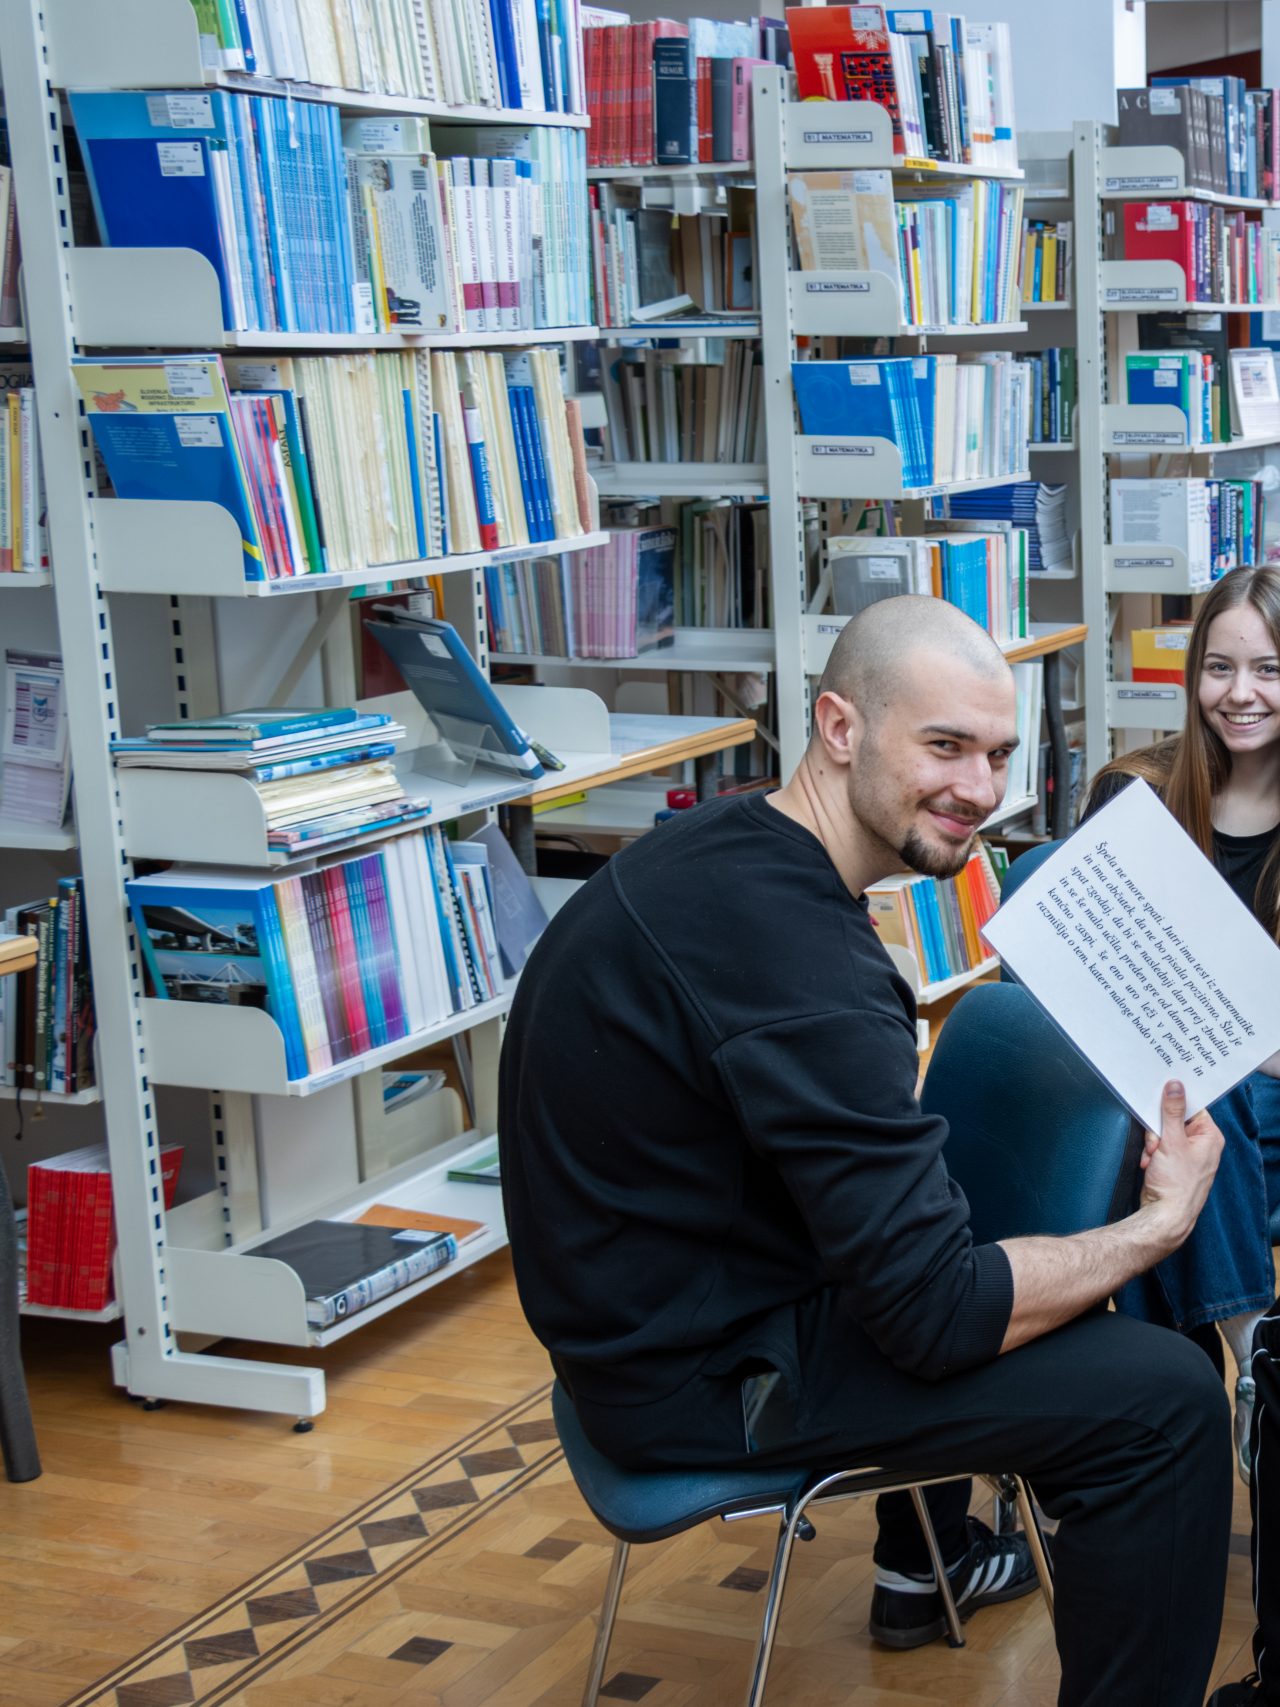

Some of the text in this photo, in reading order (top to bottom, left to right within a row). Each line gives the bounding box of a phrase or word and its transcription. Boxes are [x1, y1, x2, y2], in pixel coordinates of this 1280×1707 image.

[503, 189, 515, 281] TEMELJI LOGISTIČKE ŠPEDICIJE
[60, 900, 70, 931] Fisch
[1036, 901, 1069, 939] razmišlja
[1072, 945, 1087, 965] tem,
[1088, 962, 1111, 989] katere
[1109, 990, 1133, 1017] naloge
[1131, 1016, 1150, 1038] bodo
[1154, 1044, 1172, 1067] testu.
[1047, 887, 1073, 918] končno
[1074, 923, 1097, 948] zaspi,
[1097, 949, 1108, 960] še
[1109, 965, 1124, 980] eno
[1125, 984, 1139, 999] uro
[1140, 1001, 1158, 1018] leži
[1162, 1032, 1194, 1062] postelji
[1192, 1065, 1203, 1076] in
[1058, 875, 1216, 1066] in se še malo učila, preden gre od doma. Preden
[1070, 866, 1229, 1056] spat zgodaj, da bi se naslednji dan prej zbudila
[1082, 853, 1242, 1046] in ima občutek, da ne bo pisala pozitivno. Šla je
[1095, 841, 1254, 1035] Špela ne more spati. Jutri ima test iz matematike
